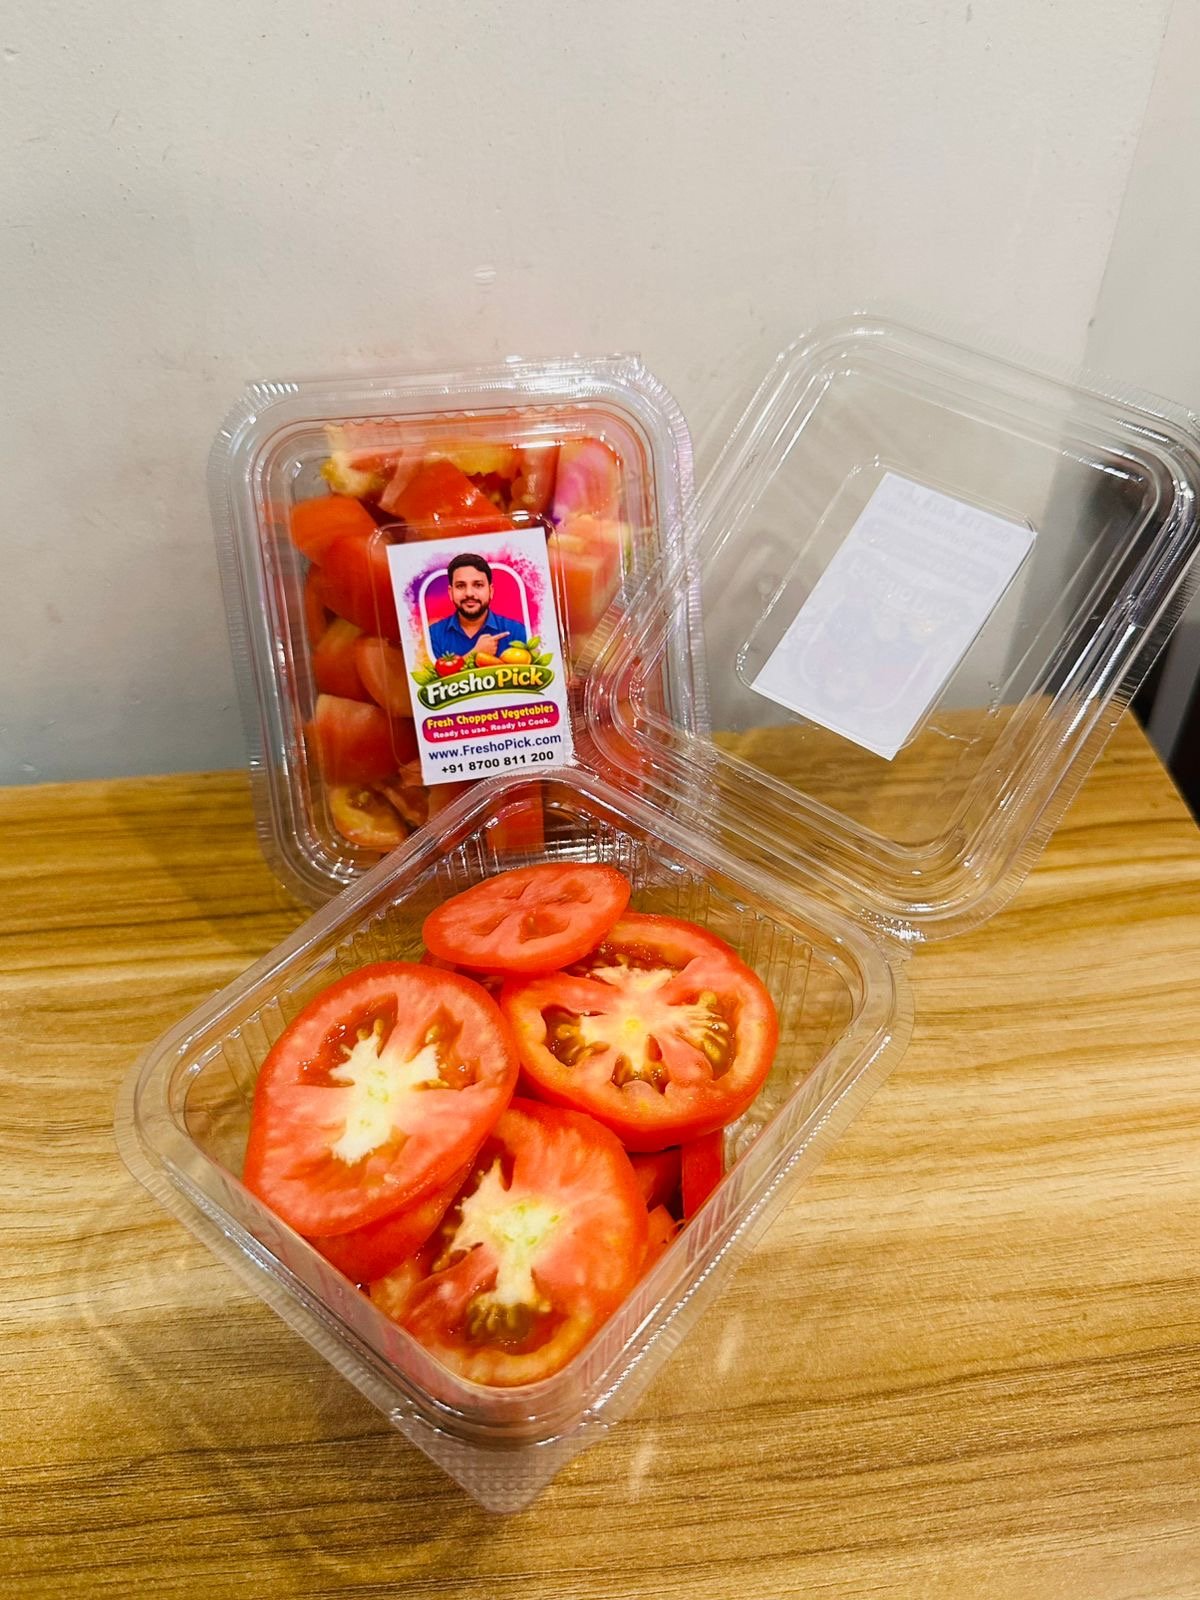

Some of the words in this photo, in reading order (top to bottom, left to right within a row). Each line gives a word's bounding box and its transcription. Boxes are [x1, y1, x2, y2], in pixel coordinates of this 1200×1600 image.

[426, 715, 454, 730] Fresh
[456, 711, 499, 726] Chopped
[501, 704, 554, 719] Vegetables
[433, 730, 459, 739] Ready
[491, 723, 515, 732] Ready
[528, 717, 551, 726] Cook.
[428, 734, 561, 760] www.FreshoPick.com
[441, 763, 464, 774] +91
[468, 758, 500, 771] 8700
[503, 754, 526, 766] 811
[530, 751, 554, 762] 200
